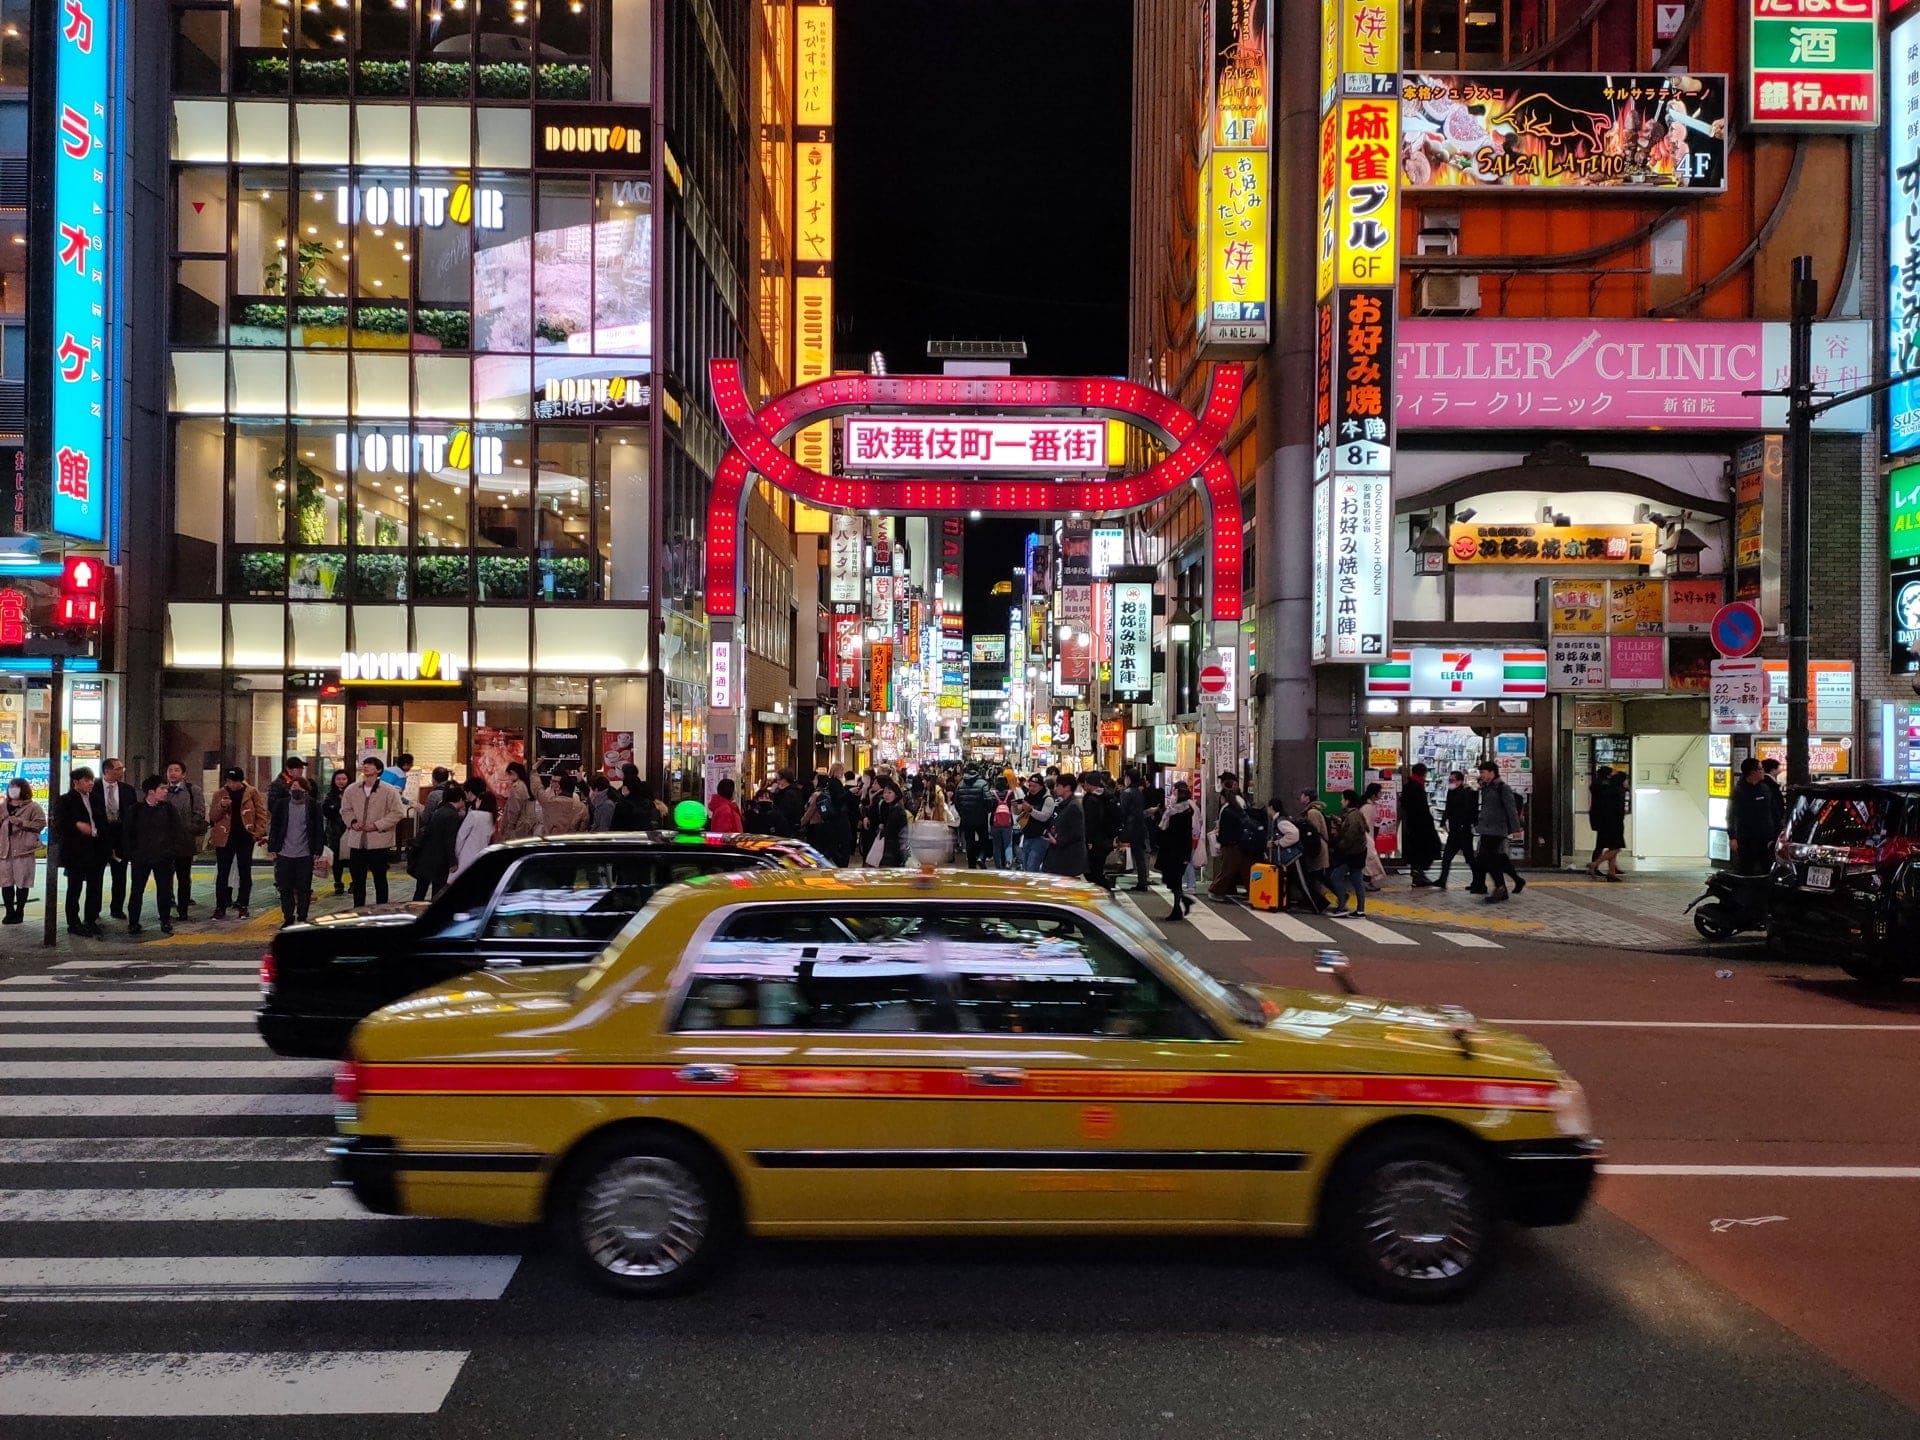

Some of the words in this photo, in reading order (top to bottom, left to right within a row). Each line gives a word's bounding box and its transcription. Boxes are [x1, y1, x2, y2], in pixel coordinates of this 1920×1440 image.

[1789, 26, 1838, 64] 酒
[1374, 73, 1393, 93] 7F
[1403, 86, 1504, 101] 本格シュラスコ
[1602, 86, 1711, 101] サルサラティーノ
[1759, 81, 1868, 111] 銀行ATM
[545, 126, 641, 154] DOUTOR
[818, 130, 826, 142] 5
[1225, 119, 1255, 141] 4F
[1476, 148, 1540, 177] SALSA
[1676, 152, 1711, 178] 4F
[1238, 157, 1261, 207] お好み
[1345, 104, 1390, 251] 麻雀ブル
[337, 183, 504, 229] DOUTOR
[804, 168, 825, 257] すずや
[817, 264, 826, 276] 4
[1352, 256, 1382, 279] 6F
[1243, 303, 1260, 319] 7F
[1346, 294, 1382, 415] お好み焼
[1595, 342, 1757, 382] CLINIC
[545, 376, 641, 403] DOUTOR
[1487, 391, 1613, 416] クリニック
[1662, 397, 1716, 414] 新宿院
[1340, 416, 1387, 440] 本陣
[336, 430, 503, 475] DOUTOR
[856, 426, 1097, 462] 歌舞伎町一番街
[1347, 445, 1379, 466] 8F
[873, 564, 892, 574] B1F
[1338, 497, 1359, 636] お好み焼き本陣
[1362, 636, 1382, 652] 2F
[1617, 641, 1656, 650] FILLER
[340, 650, 459, 680] DOUTOR
[1571, 677, 1584, 687] 2F
[1715, 683, 1729, 694] 22
